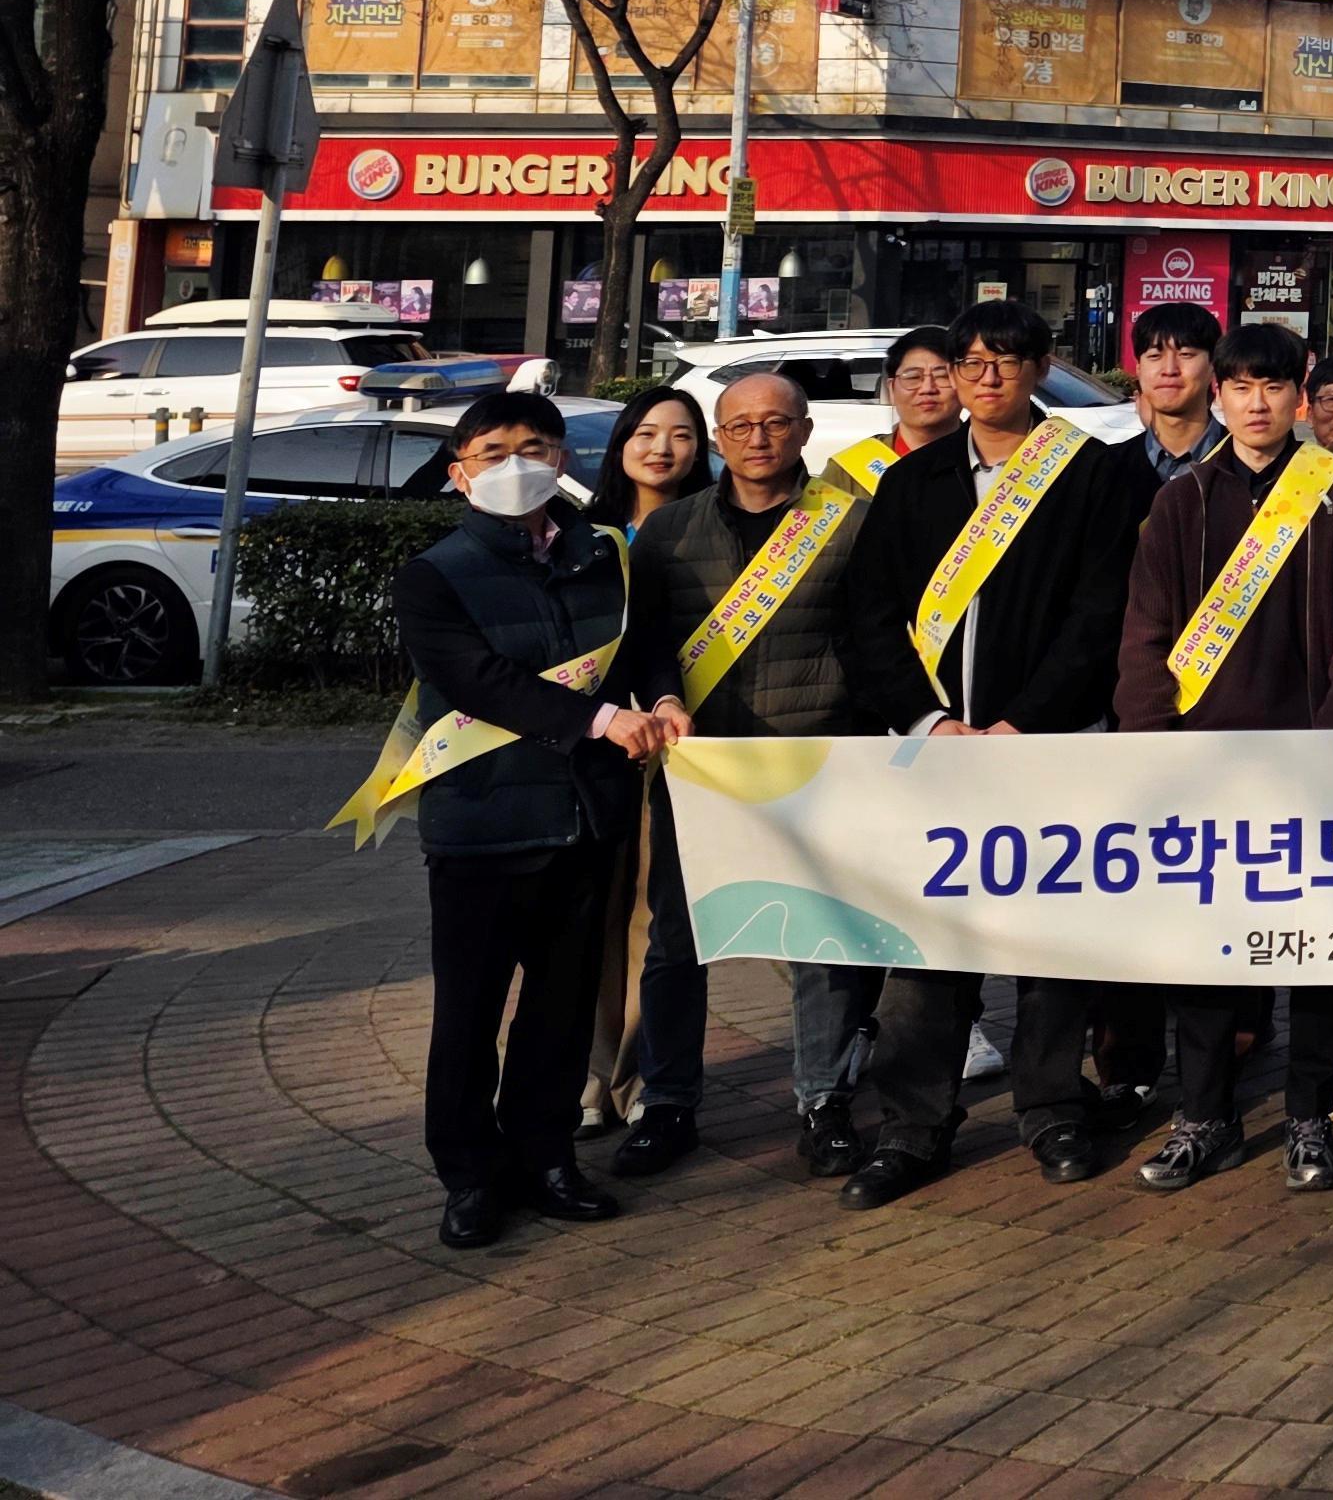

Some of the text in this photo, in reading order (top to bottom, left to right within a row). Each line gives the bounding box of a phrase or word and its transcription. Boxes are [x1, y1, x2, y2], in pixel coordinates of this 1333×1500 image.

[327, 3, 404, 25] 자신만만
[414, 154, 610, 195] BURGER
[1085, 165, 1250, 206] BURGER
[1142, 283, 1211, 300] PARKING
[991, 442, 1068, 547] 관심과 배려가
[768, 507, 811, 564] 행복한
[771, 537, 817, 590] 관심과
[731, 592, 777, 645] 배려가
[1183, 537, 1264, 654] 행복한 교실을
[1195, 525, 1294, 677] 작은 관심과 배려가
[1246, 929, 1317, 965] 일자:
